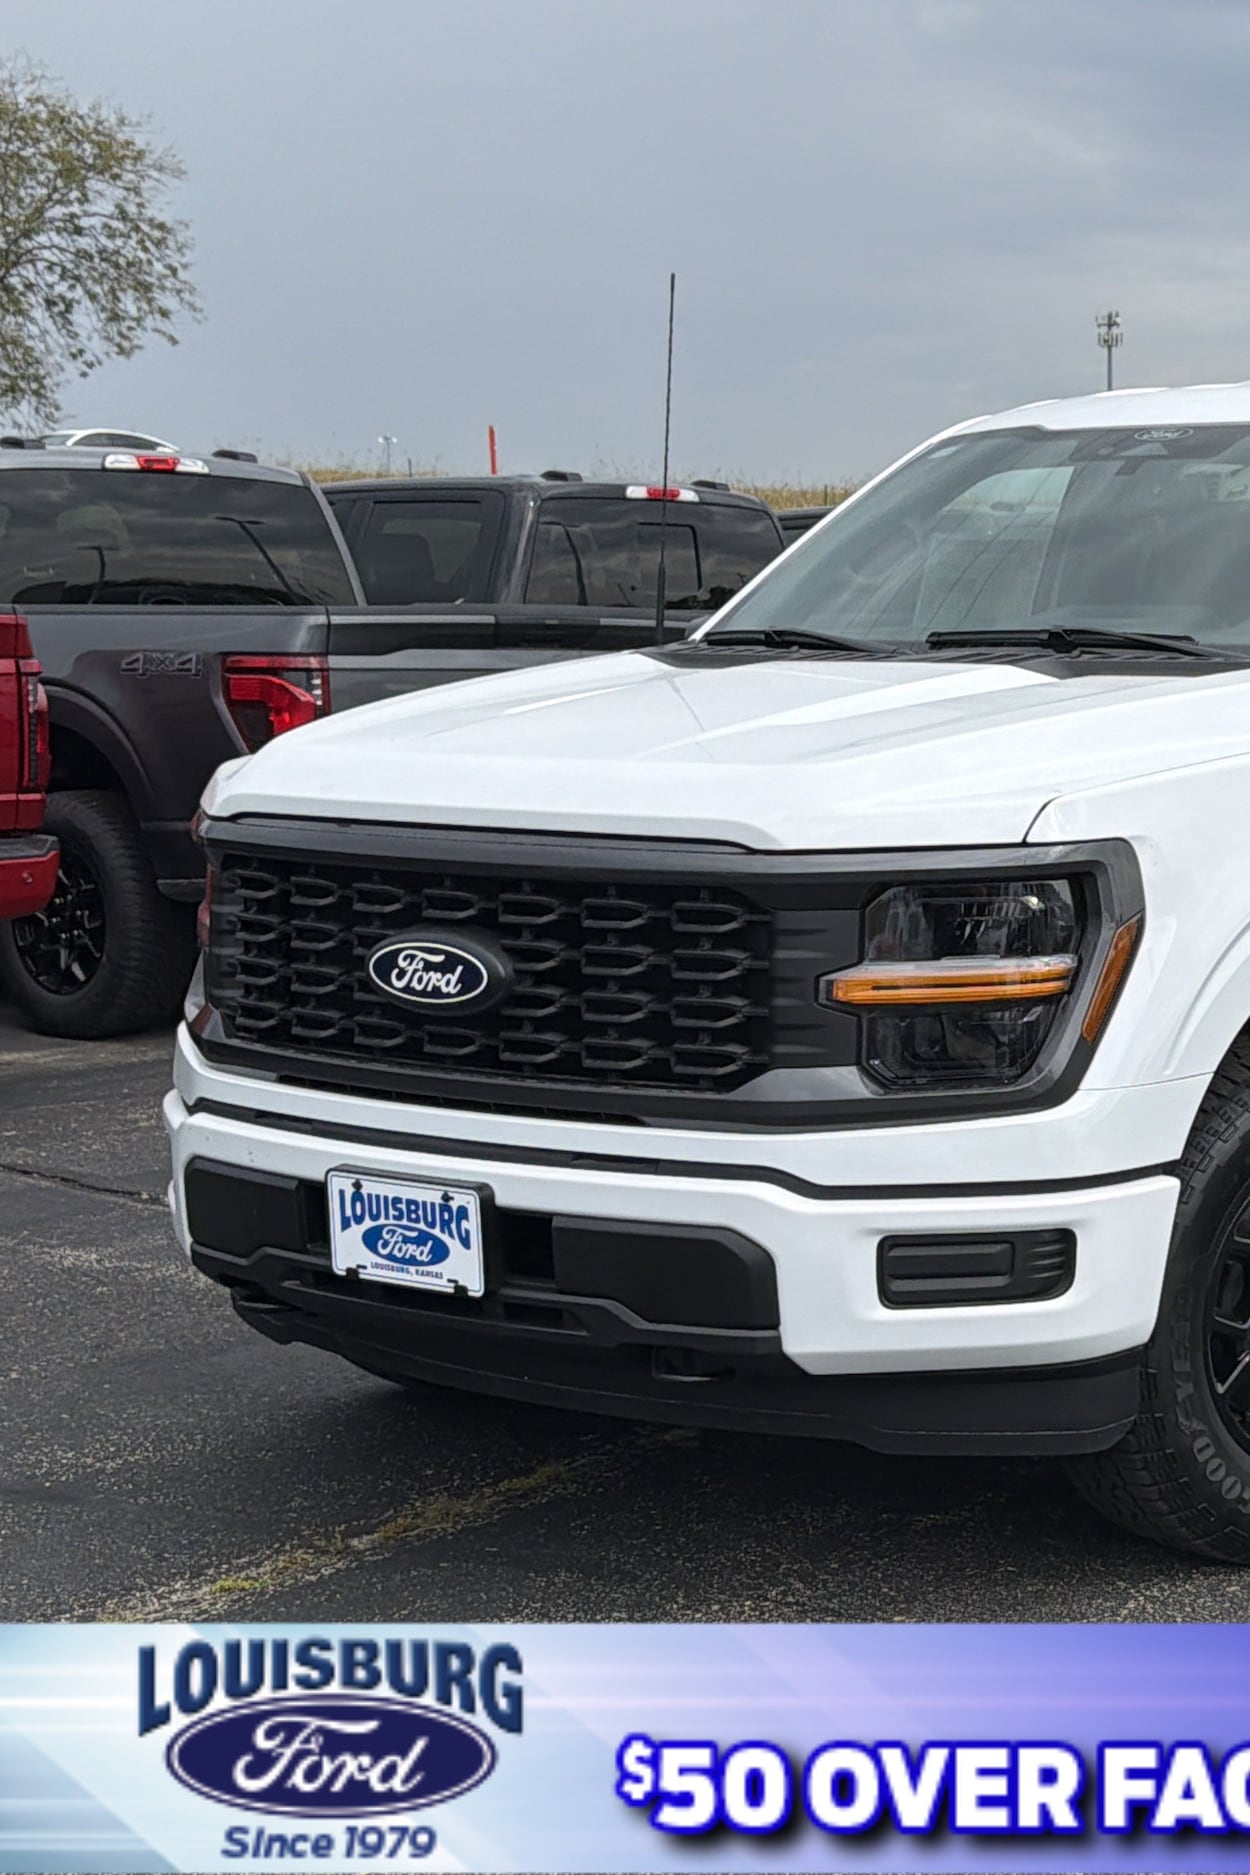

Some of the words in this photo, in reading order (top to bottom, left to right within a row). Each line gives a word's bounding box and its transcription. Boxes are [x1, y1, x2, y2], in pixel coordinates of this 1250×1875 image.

[391, 949, 463, 994] Ford
[338, 1188, 472, 1251] LOUISBURG
[377, 1226, 434, 1262] Ford
[415, 1268, 443, 1279] KANSAS
